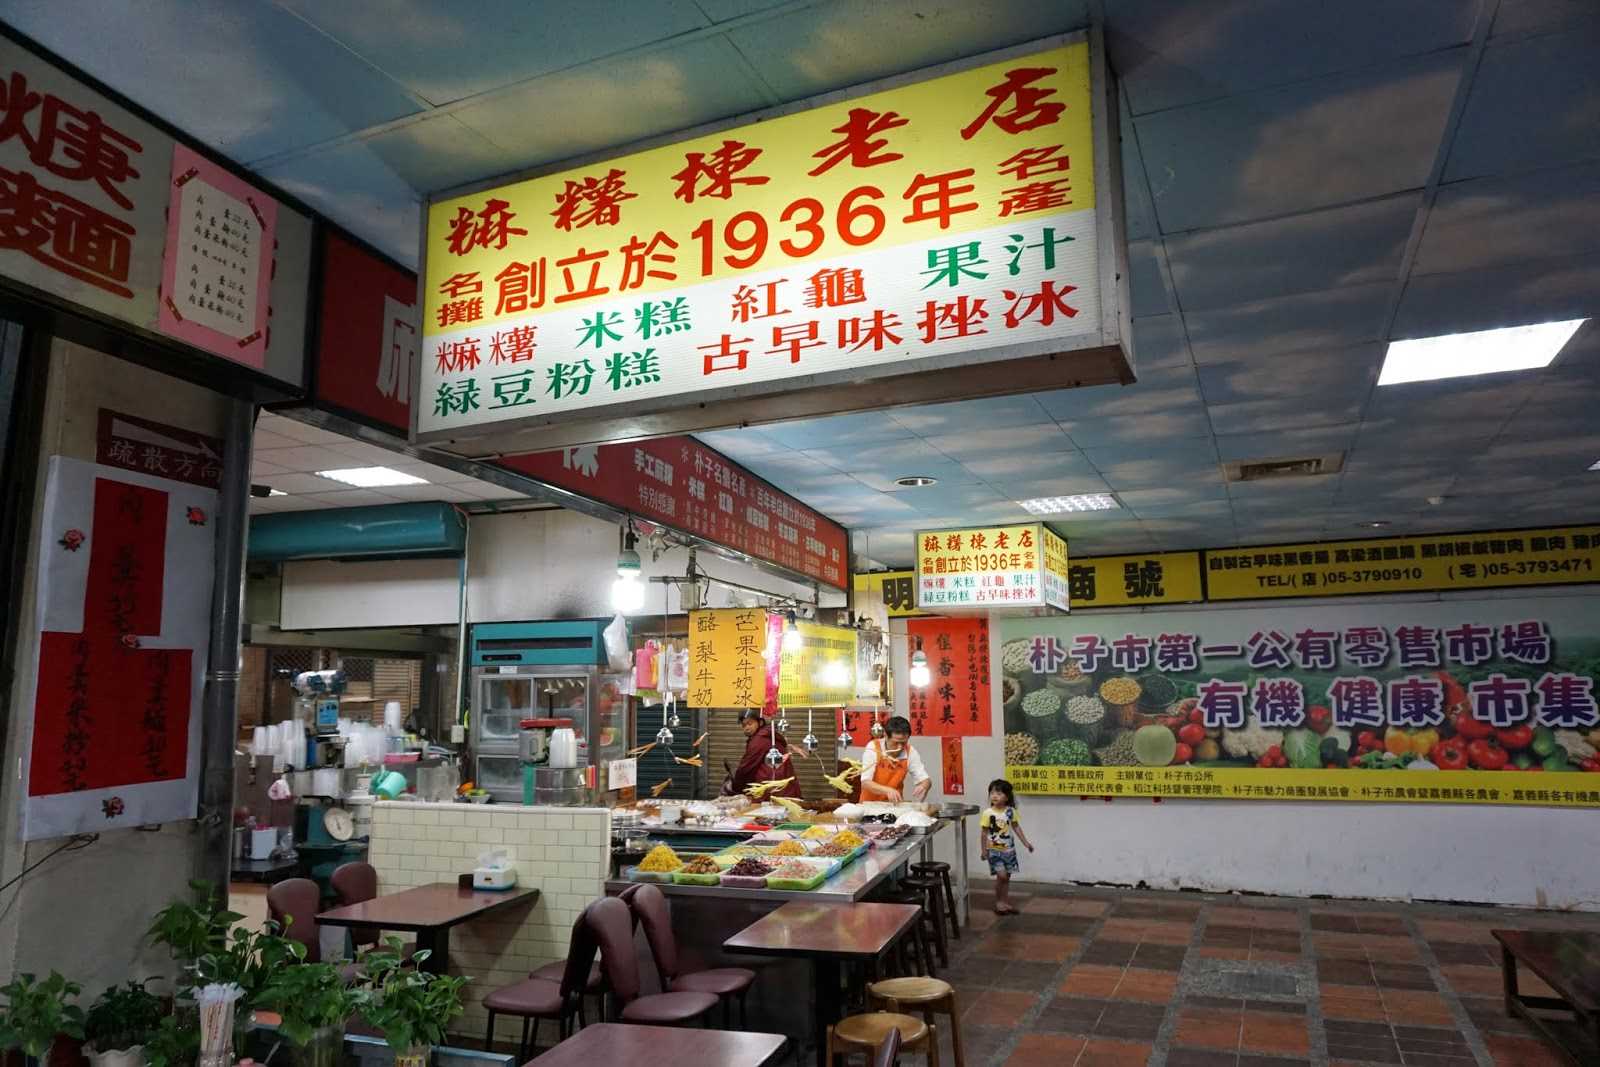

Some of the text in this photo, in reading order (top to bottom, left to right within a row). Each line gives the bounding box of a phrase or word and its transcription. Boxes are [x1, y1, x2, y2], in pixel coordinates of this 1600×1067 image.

[997, 143, 1074, 218] 名產
[494, 167, 981, 317] 創立於1936年
[918, 226, 1077, 292] 果汁
[436, 271, 485, 328] 名攤
[574, 296, 693, 350] 米糕
[731, 266, 869, 324] 紅龜
[697, 279, 1080, 377] 古早味挫冰
[107, 439, 223, 481] 疏散方向
[935, 553, 1021, 574] 創立於1936年
[692, 615, 720, 707] 酪梨牛奶
[732, 613, 760, 707] 芒果牛奶冰
[1030, 620, 1549, 673] 朴子市第一公有零售市場
[1199, 672, 1599, 729] 有機 健康 市集
